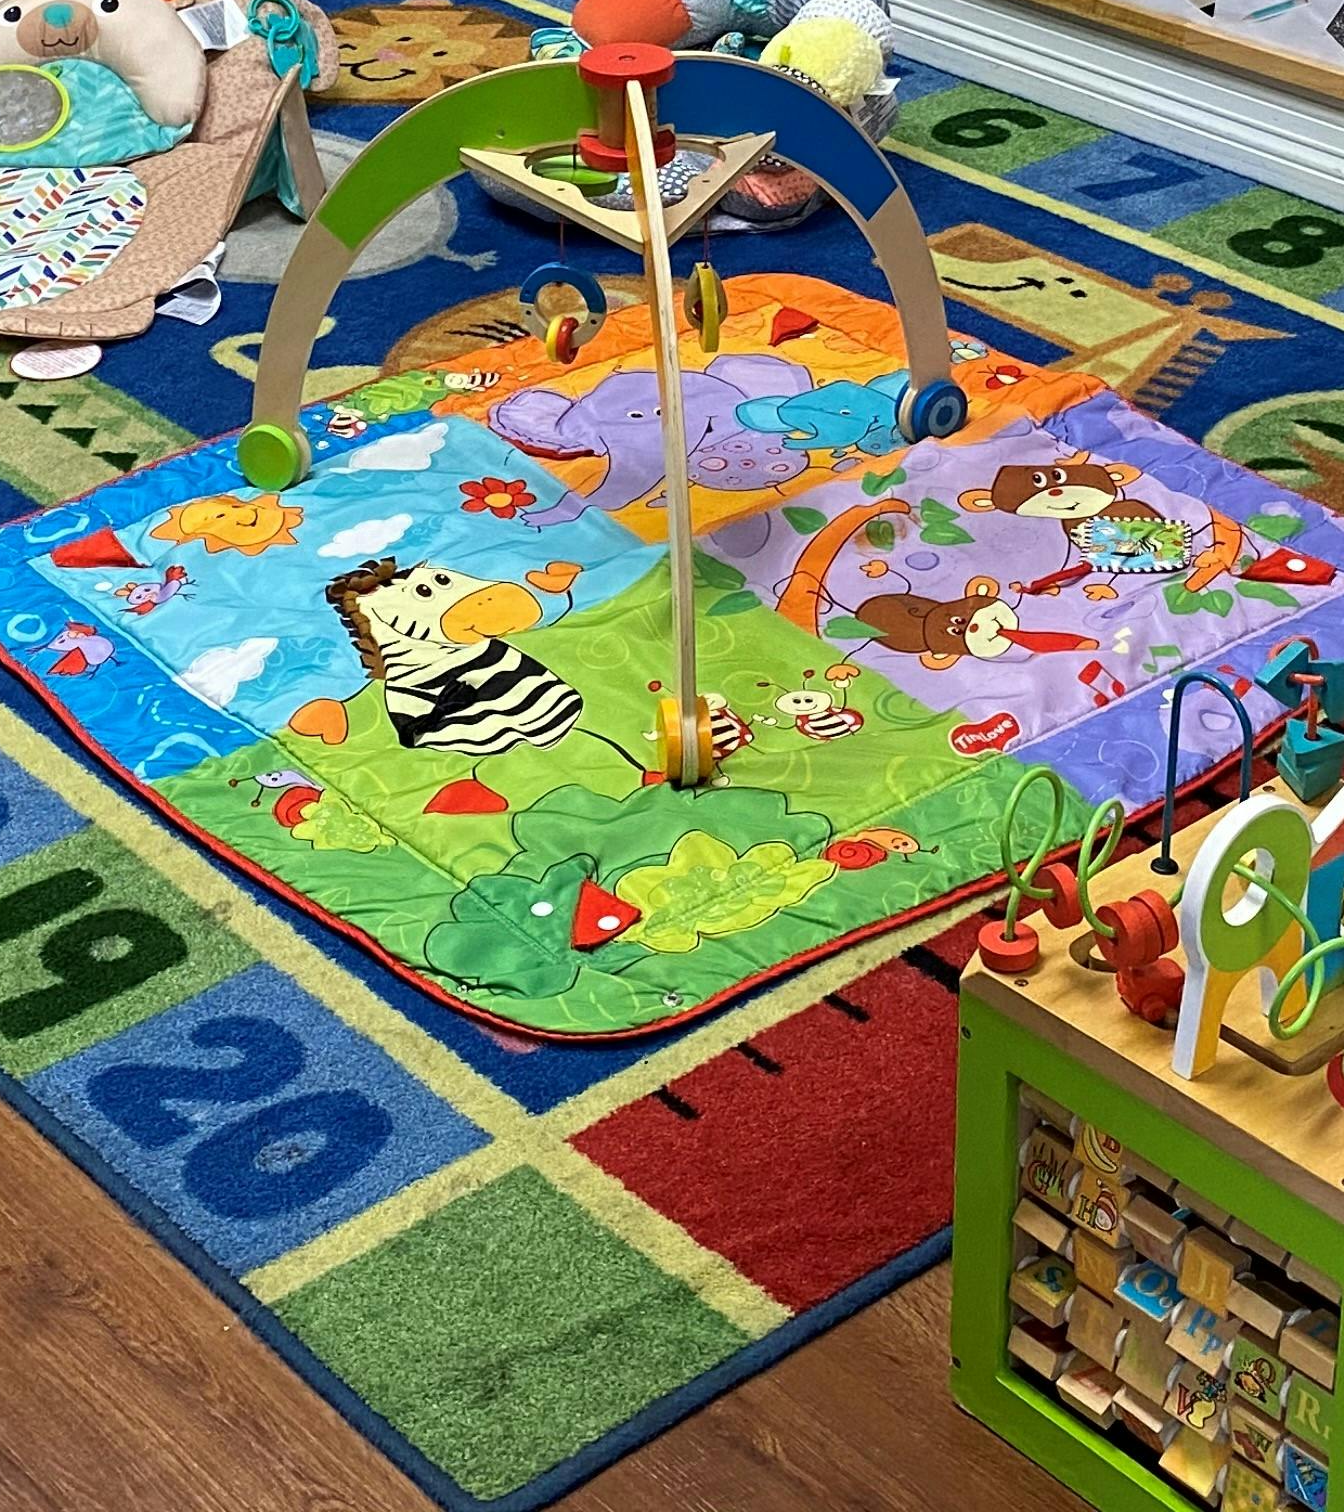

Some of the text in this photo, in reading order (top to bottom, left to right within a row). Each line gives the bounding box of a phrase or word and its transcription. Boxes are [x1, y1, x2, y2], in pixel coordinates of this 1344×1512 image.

[931, 108, 1048, 149] 6
[1076, 153, 1205, 201] 7
[86, 1014, 395, 1222] 20
